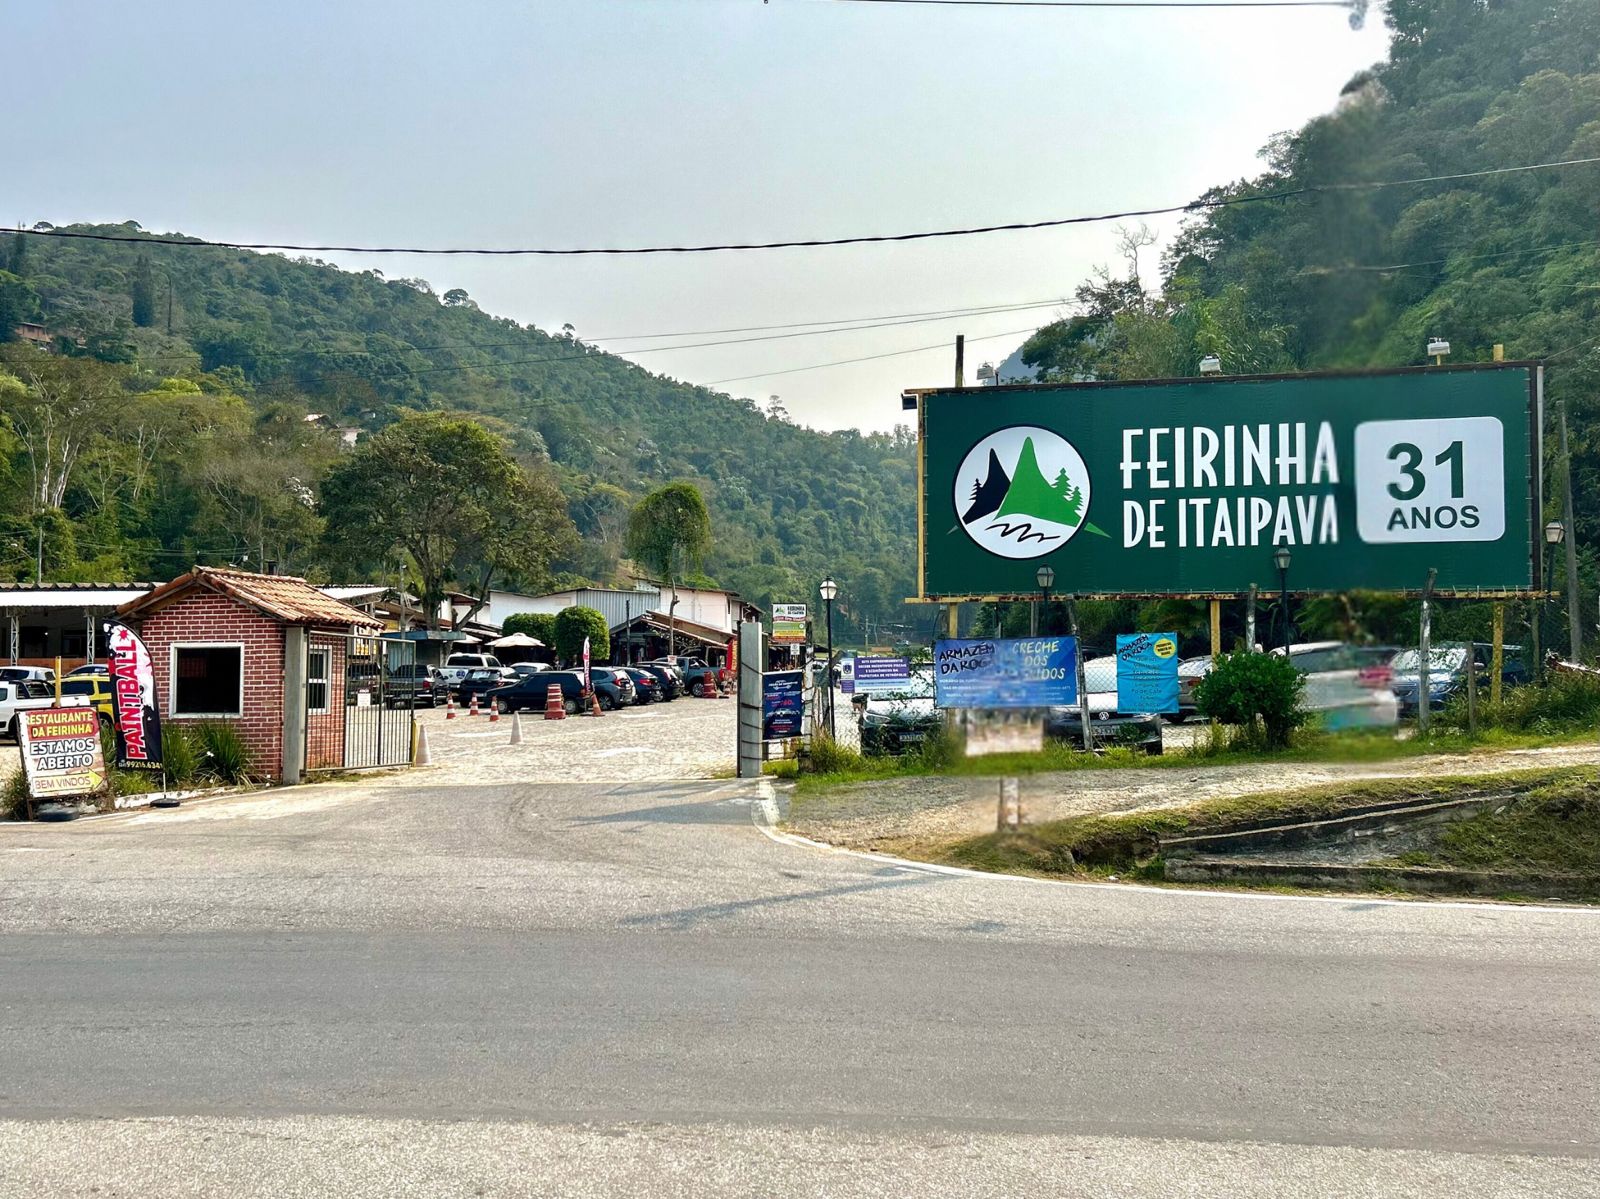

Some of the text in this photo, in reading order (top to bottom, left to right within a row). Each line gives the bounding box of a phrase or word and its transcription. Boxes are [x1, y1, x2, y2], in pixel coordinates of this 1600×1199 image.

[1120, 420, 1339, 490] FEIRINHA
[1387, 440, 1467, 501] 31
[1122, 494, 1340, 549] DE ITAIPAVA
[1387, 505, 1480, 531] ANOS
[1012, 640, 1060, 654] CRECHE
[940, 662, 960, 675] DA
[115, 639, 148, 760] PAINTBALL
[26, 711, 93, 726] RESTAURANTE
[32, 724, 92, 738] DA FEIRINHA
[30, 738, 95, 755] ESTAMOS
[37, 753, 93, 771] ABERTO
[35, 776, 91, 790] BEM VINDOS
